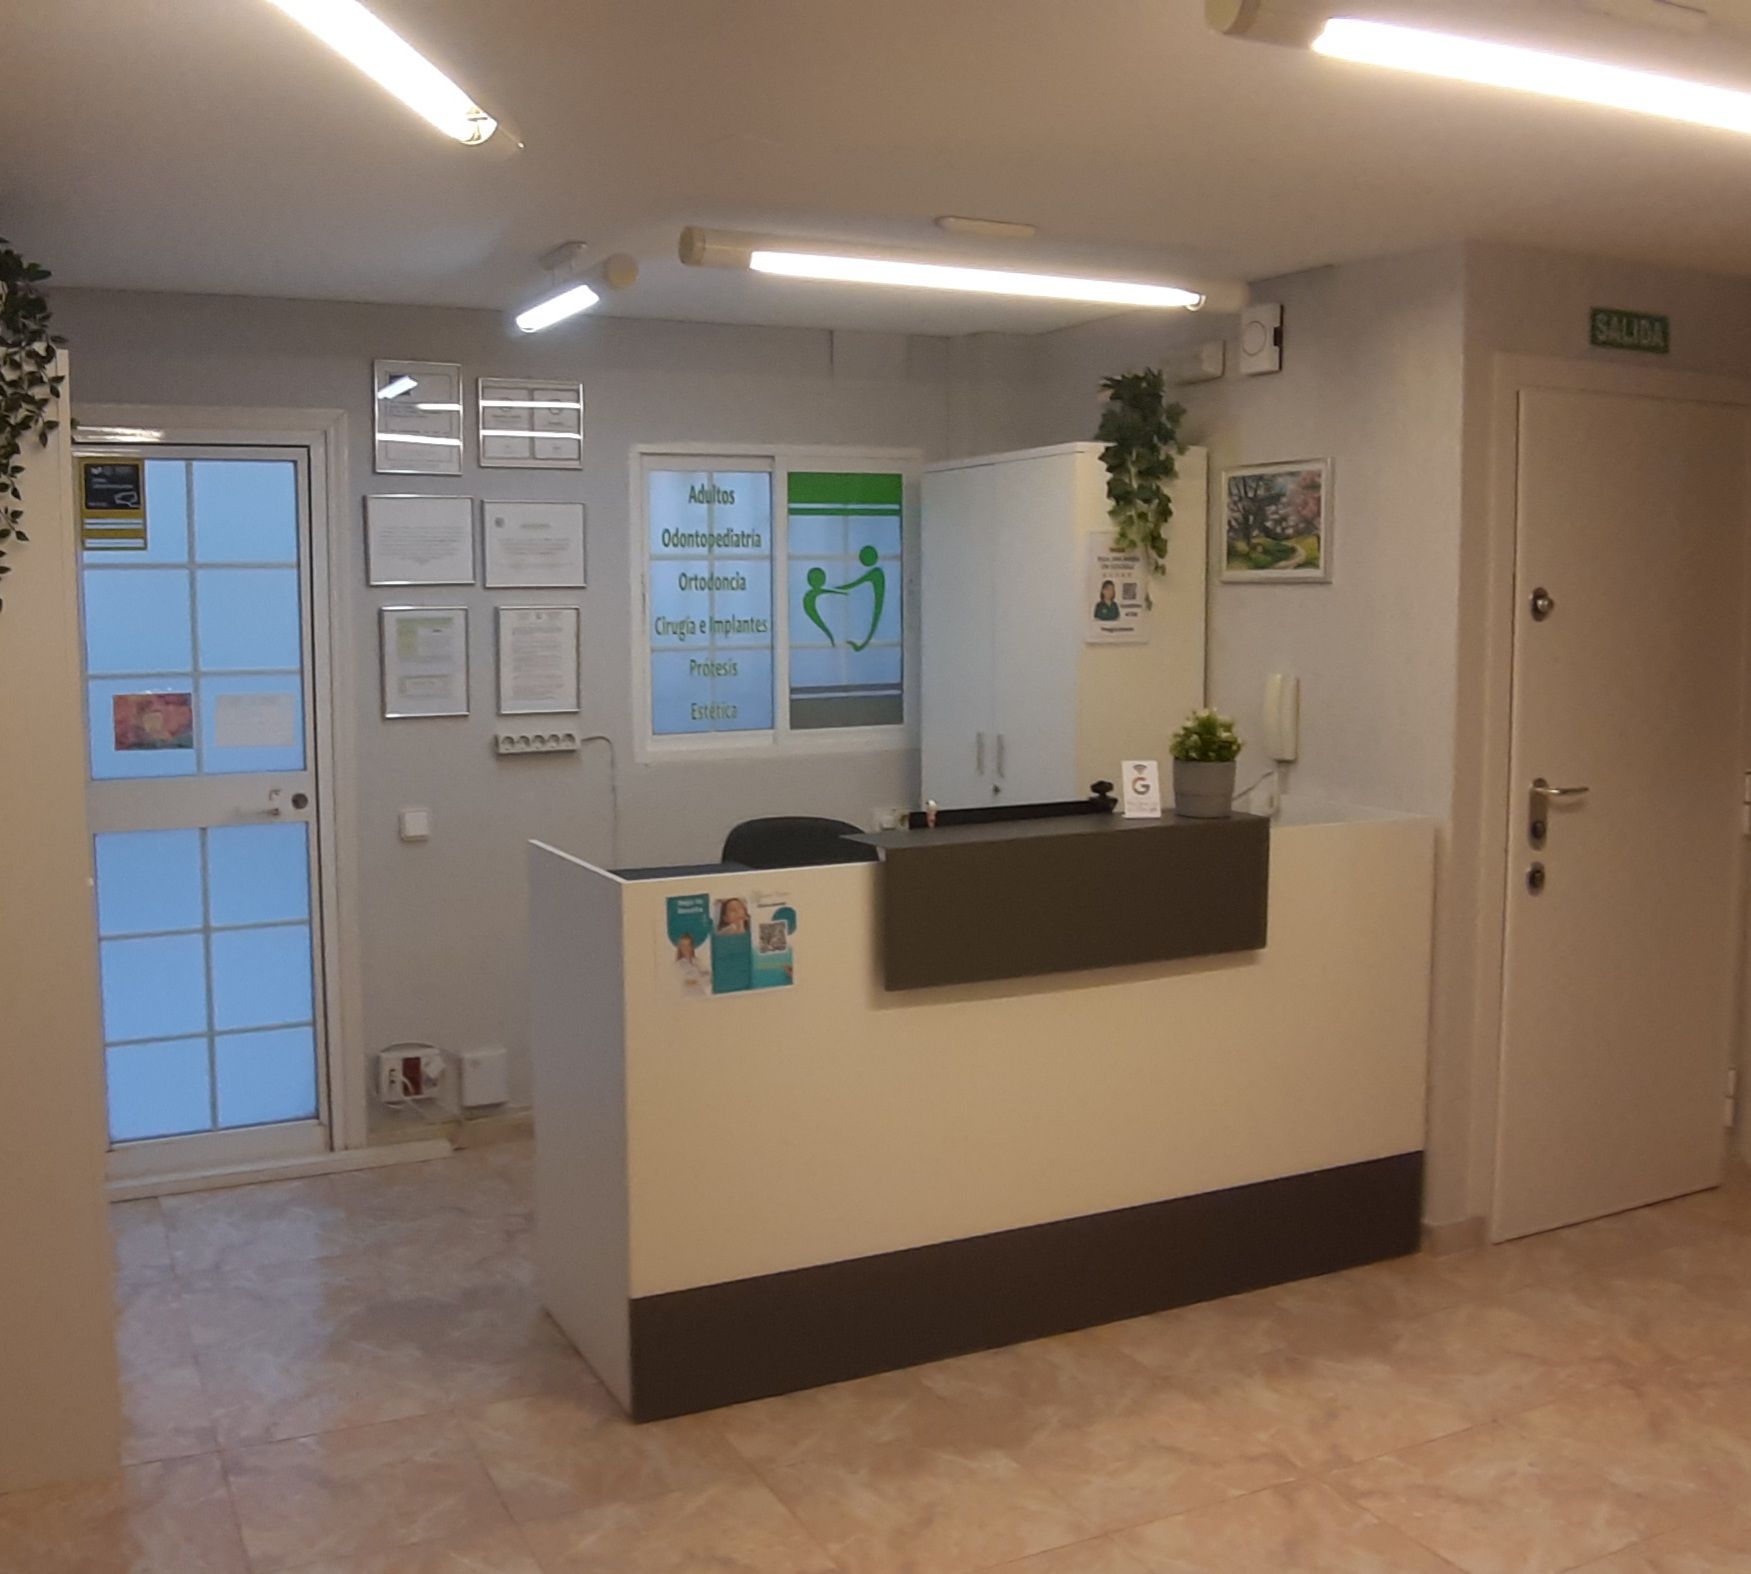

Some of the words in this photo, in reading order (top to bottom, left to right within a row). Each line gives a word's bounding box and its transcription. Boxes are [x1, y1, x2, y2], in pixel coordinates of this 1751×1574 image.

[1594, 312, 1664, 347] SALIDA
[688, 485, 735, 504] Adultos
[679, 572, 746, 591] Ortodoncia
[699, 622, 706, 634] e
[709, 615, 767, 639] Implantes
[691, 701, 737, 720] Estética
[1132, 776, 1151, 795] G
